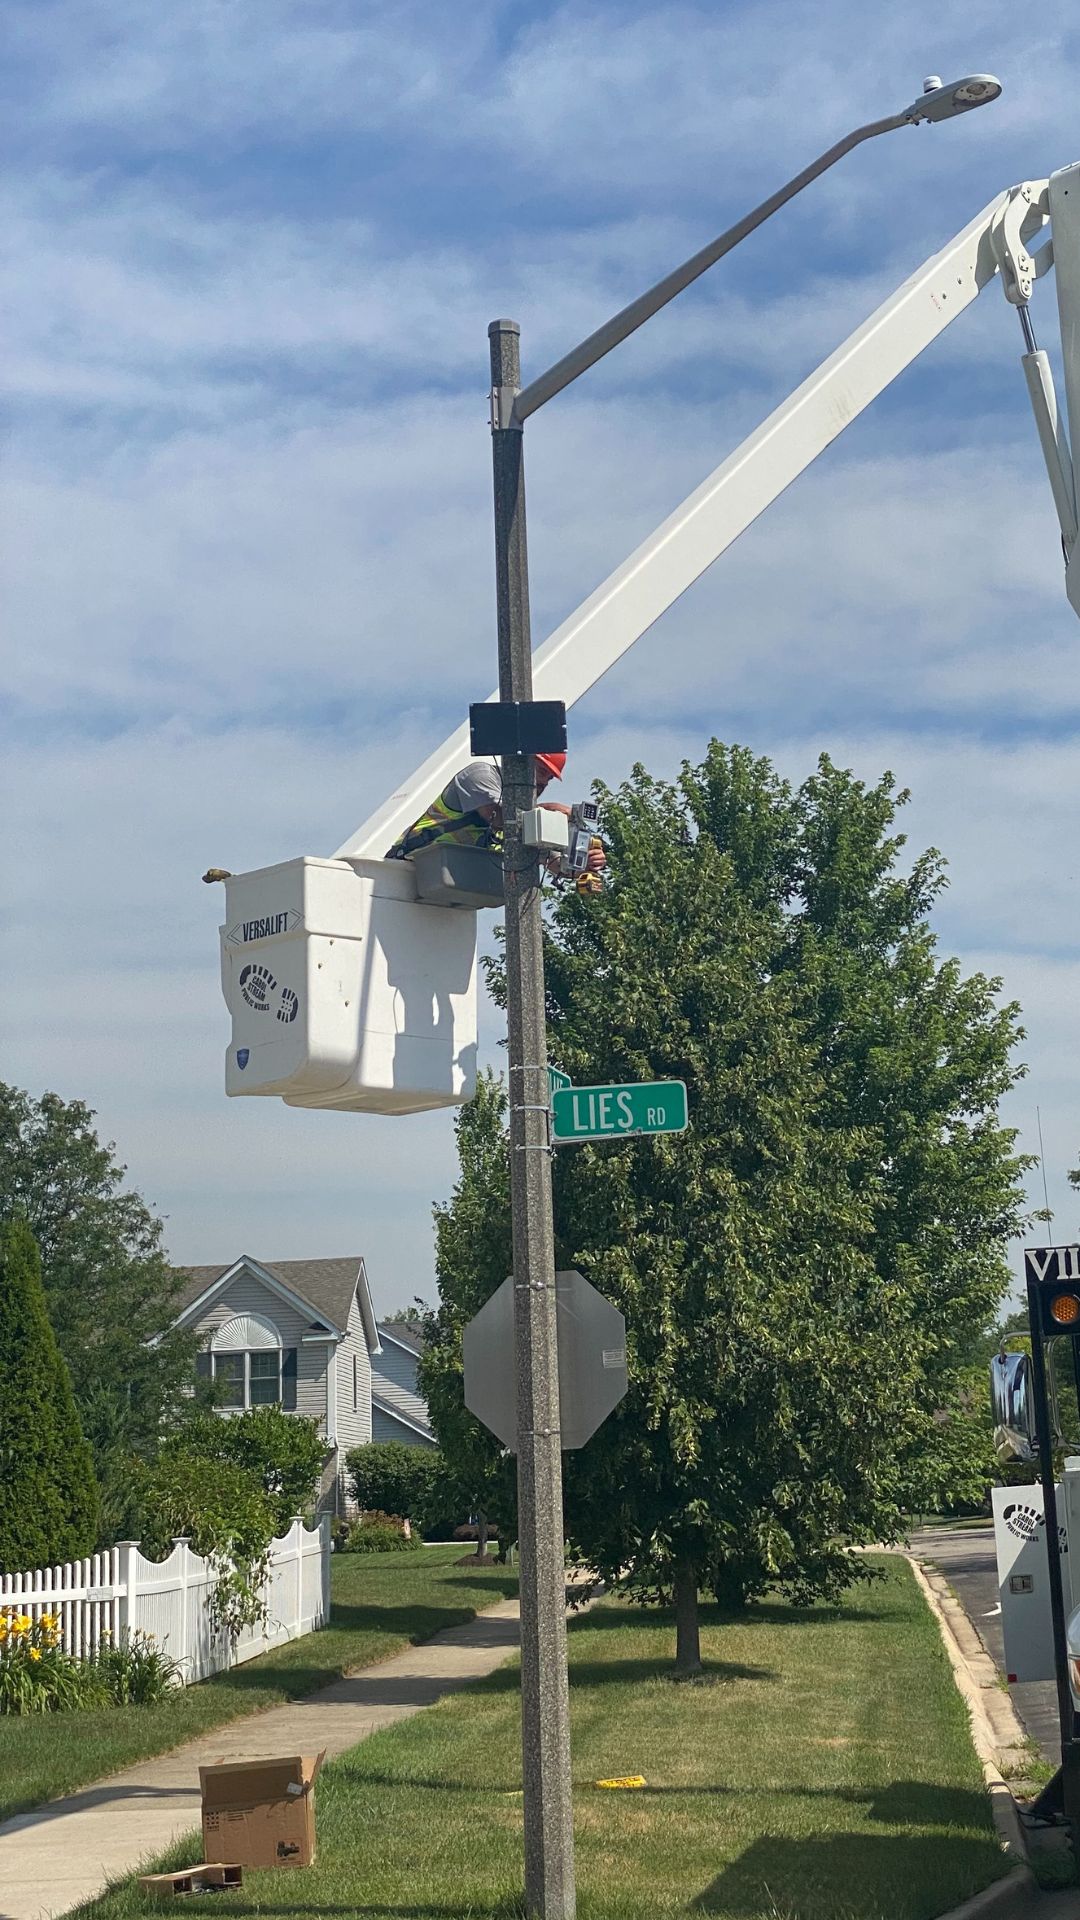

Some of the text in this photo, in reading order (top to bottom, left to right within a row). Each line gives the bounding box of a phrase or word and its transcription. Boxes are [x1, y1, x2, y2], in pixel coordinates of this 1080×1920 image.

[243, 912, 288, 942] VERSALIFT
[247, 982, 266, 1001] STREAM
[252, 976, 267, 992] CAROL
[254, 1002, 270, 1011] WORKS
[573, 1091, 666, 1131] LIES RD
[1012, 1518, 1034, 1534] STREAM
[1017, 1513, 1035, 1527] CAROL
[1005, 1521, 1039, 1542] PUBLIC WORKS
